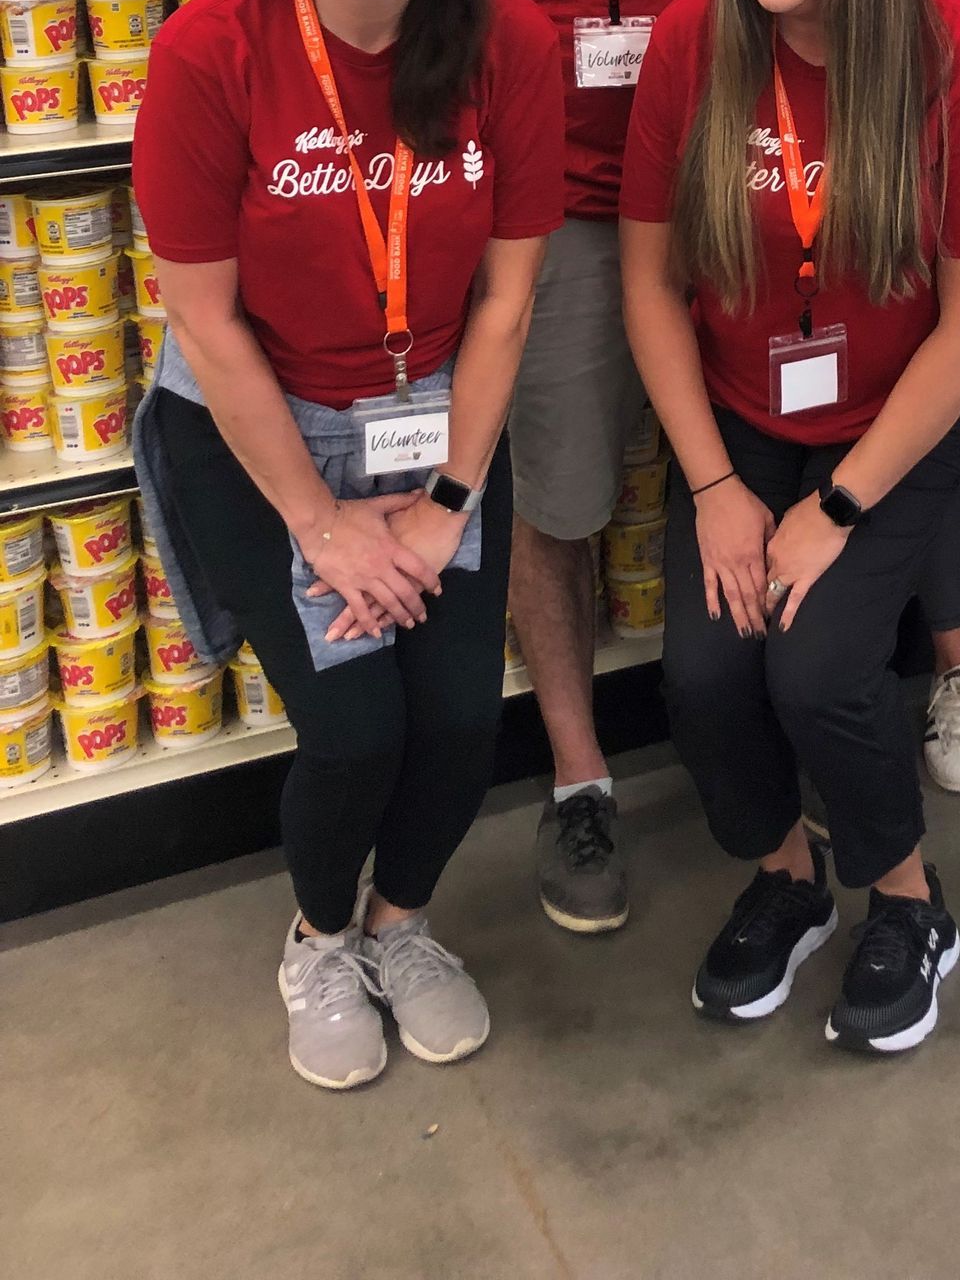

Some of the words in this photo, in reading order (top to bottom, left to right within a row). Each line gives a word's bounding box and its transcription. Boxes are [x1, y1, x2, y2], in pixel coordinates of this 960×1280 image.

[589, 49, 643, 68] Voluntee
[11, 87, 60, 120] POPS
[364, 153, 451, 197] Dys
[43, 286, 88, 318] POPS
[57, 350, 104, 384] POPS
[371, 429, 442, 451] Volunteer
[60, 665, 95, 688] OPS
[78, 720, 127, 758] POPS
